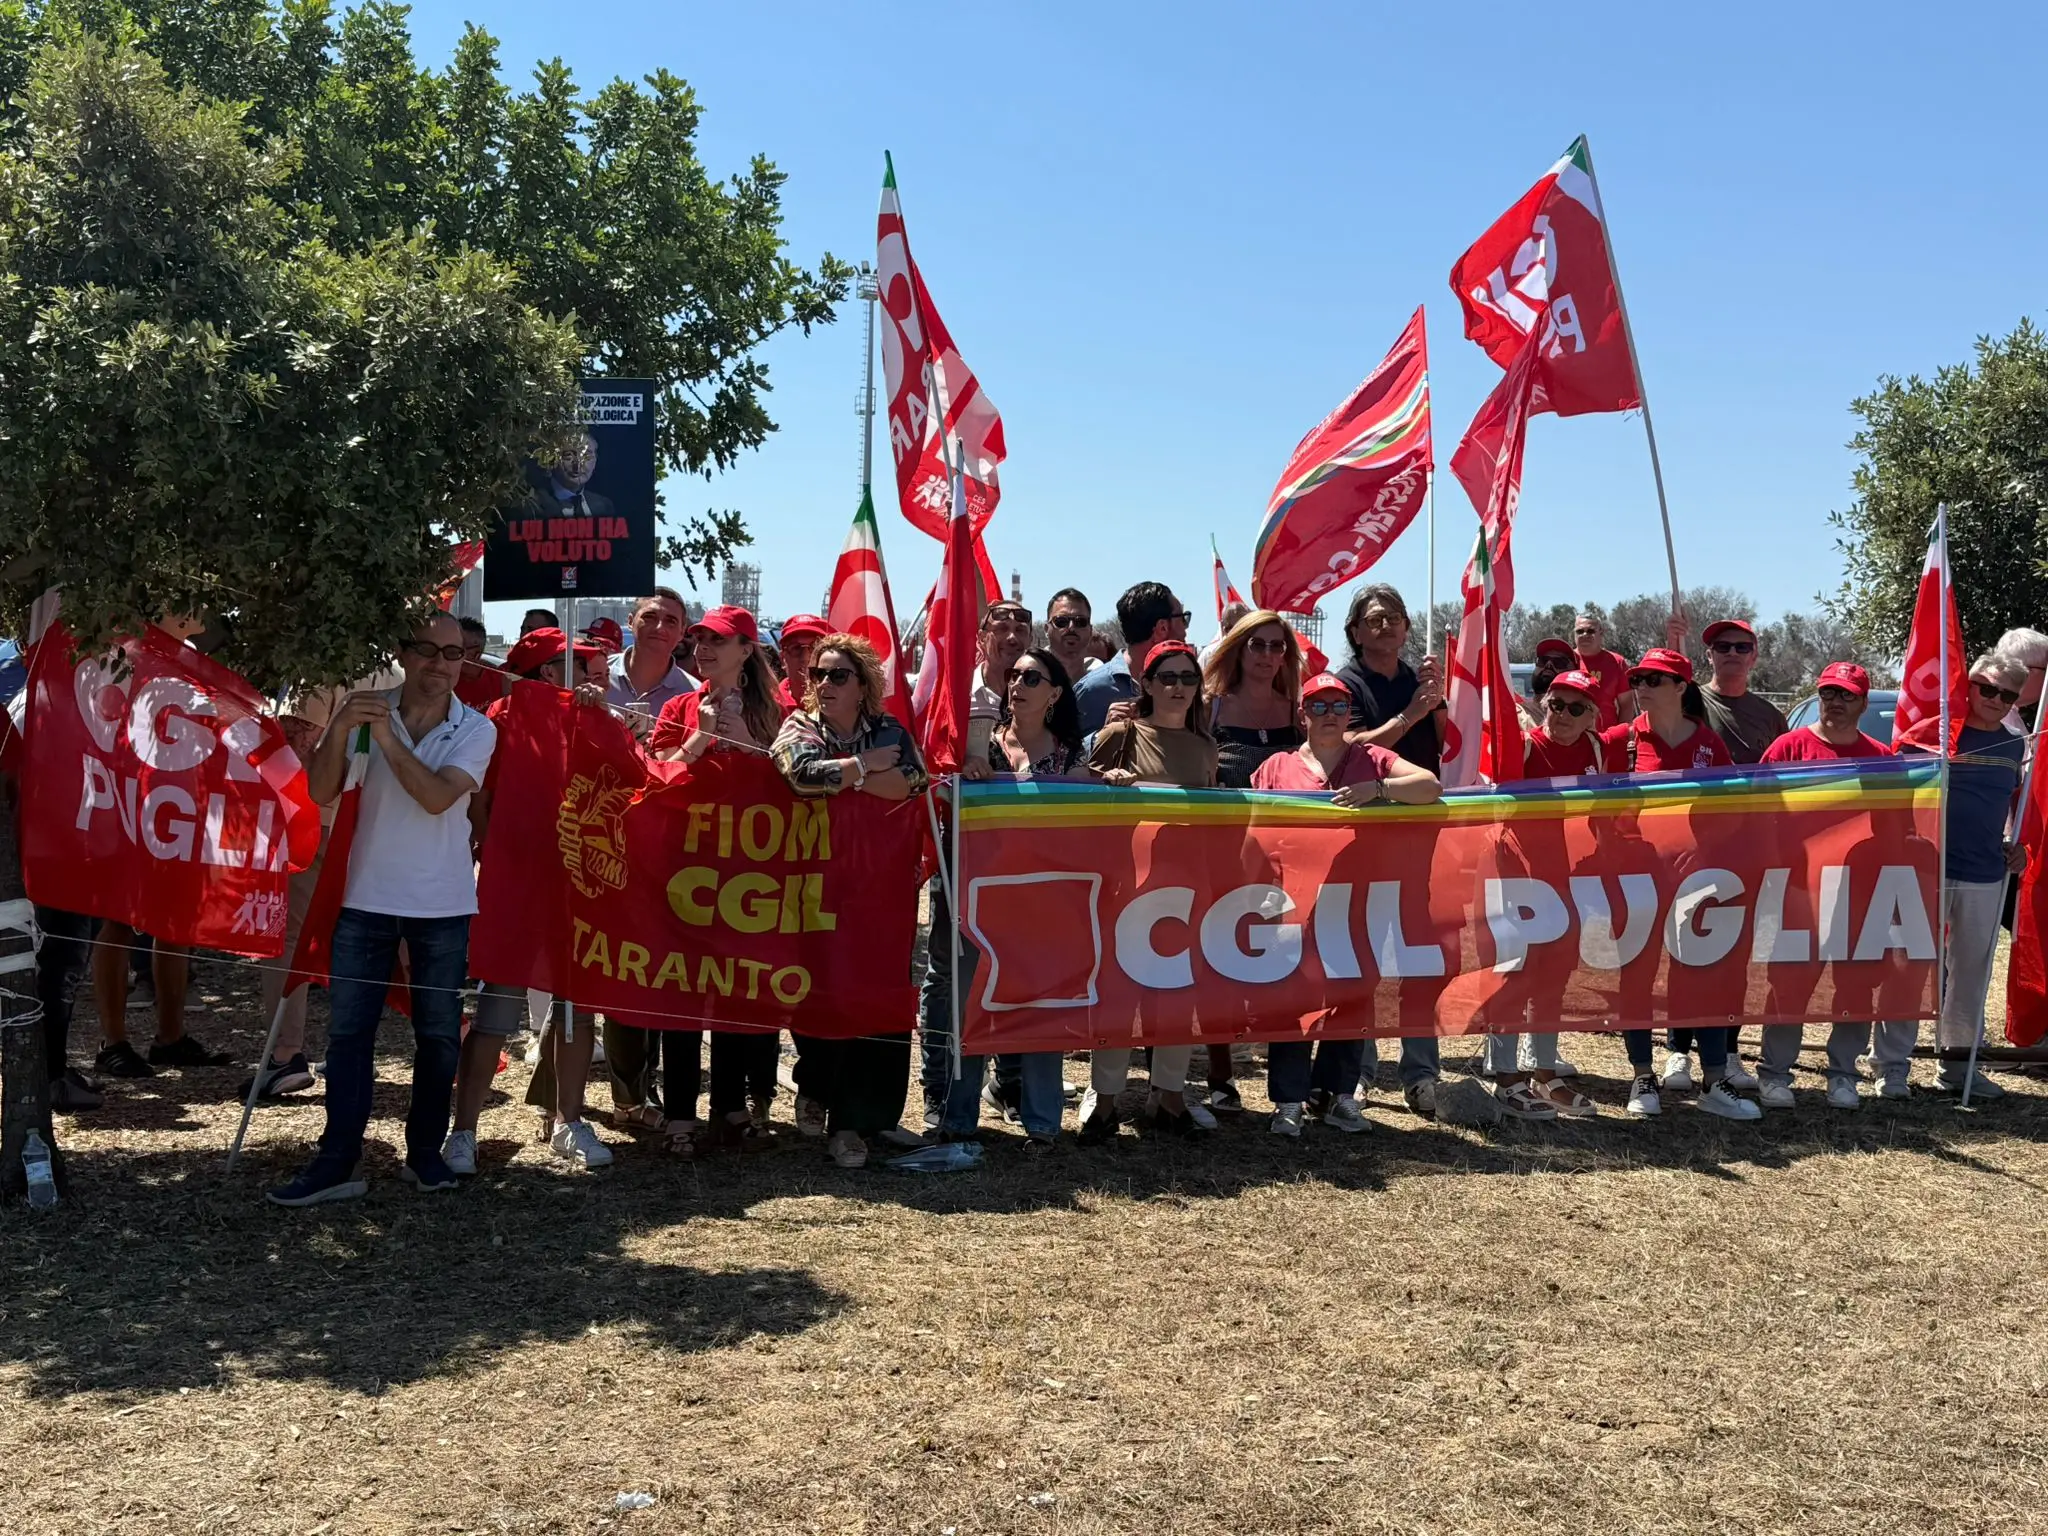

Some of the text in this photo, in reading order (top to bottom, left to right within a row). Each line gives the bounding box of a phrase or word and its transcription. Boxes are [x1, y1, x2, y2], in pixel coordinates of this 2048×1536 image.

[633, 395, 641, 408] E
[508, 516, 630, 542] LUI NON HA
[526, 540, 612, 563] VOLUTO
[683, 798, 832, 862] FIOM
[666, 866, 837, 934] CGIL
[1114, 865, 1938, 989] CGIL PUGLIA
[573, 916, 812, 1004] TARANTO
